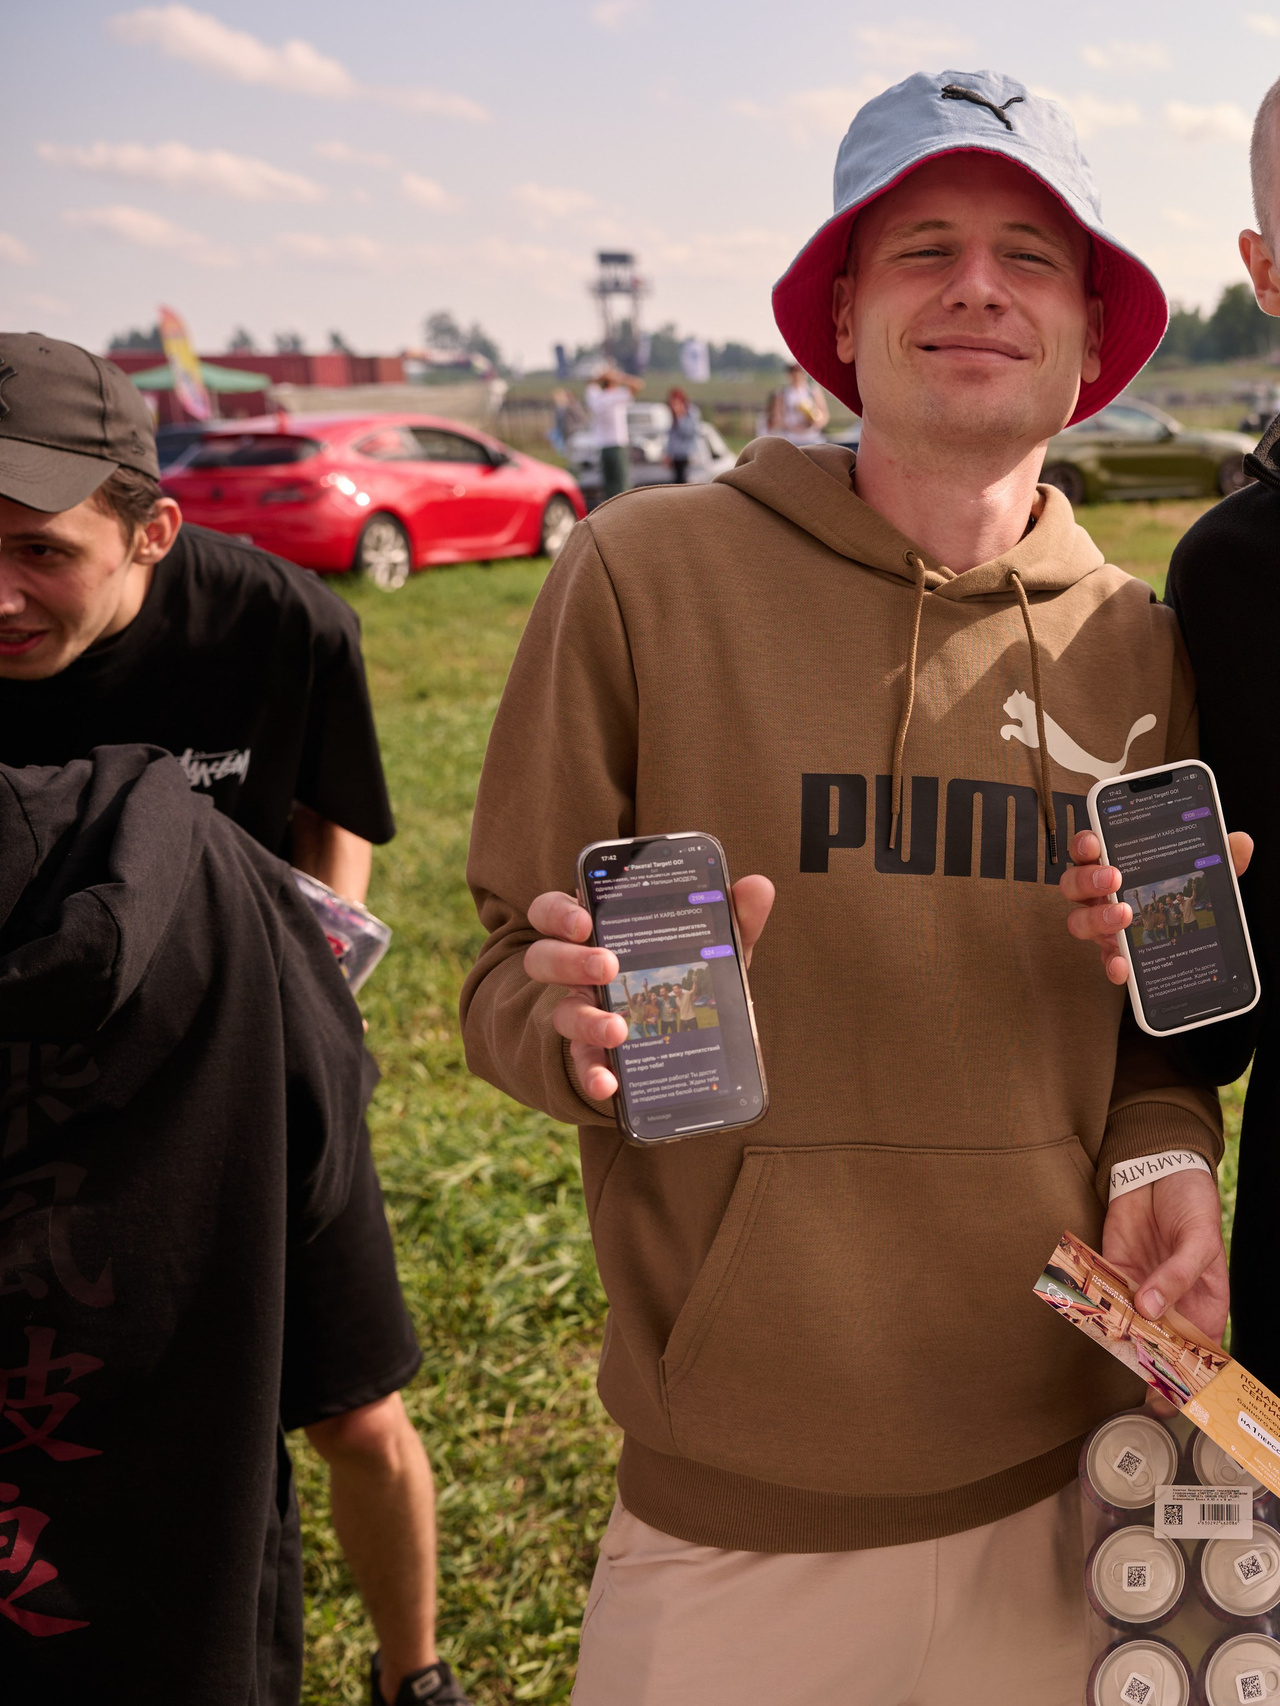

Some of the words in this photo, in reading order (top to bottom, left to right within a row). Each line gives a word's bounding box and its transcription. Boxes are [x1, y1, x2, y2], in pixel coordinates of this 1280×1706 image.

[174, 747, 251, 788] tüssy
[1234, 1396, 1269, 1428] банного
[1247, 1400, 1258, 1411] на
[1239, 1416, 1252, 1429] НА
[1251, 1425, 1257, 1433] 1
